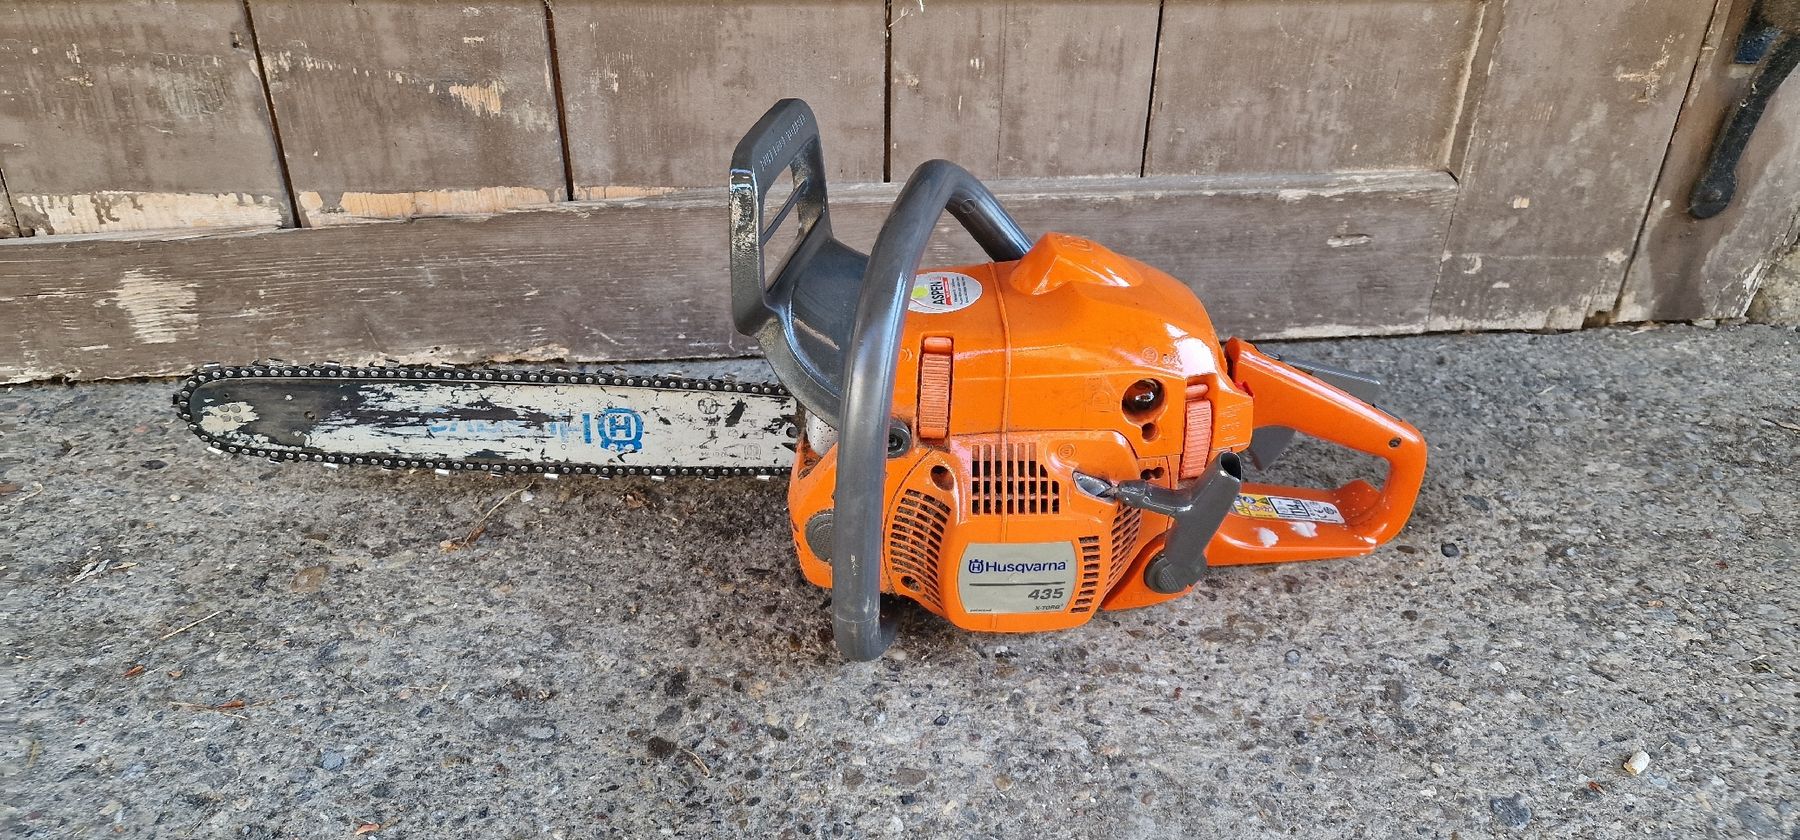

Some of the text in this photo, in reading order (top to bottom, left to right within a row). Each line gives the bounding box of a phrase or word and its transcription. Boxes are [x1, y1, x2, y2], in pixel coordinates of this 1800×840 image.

[930, 280, 945, 305] ASPEN
[985, 561, 1066, 573] Husqvarna
[1027, 588, 1065, 600] 435
